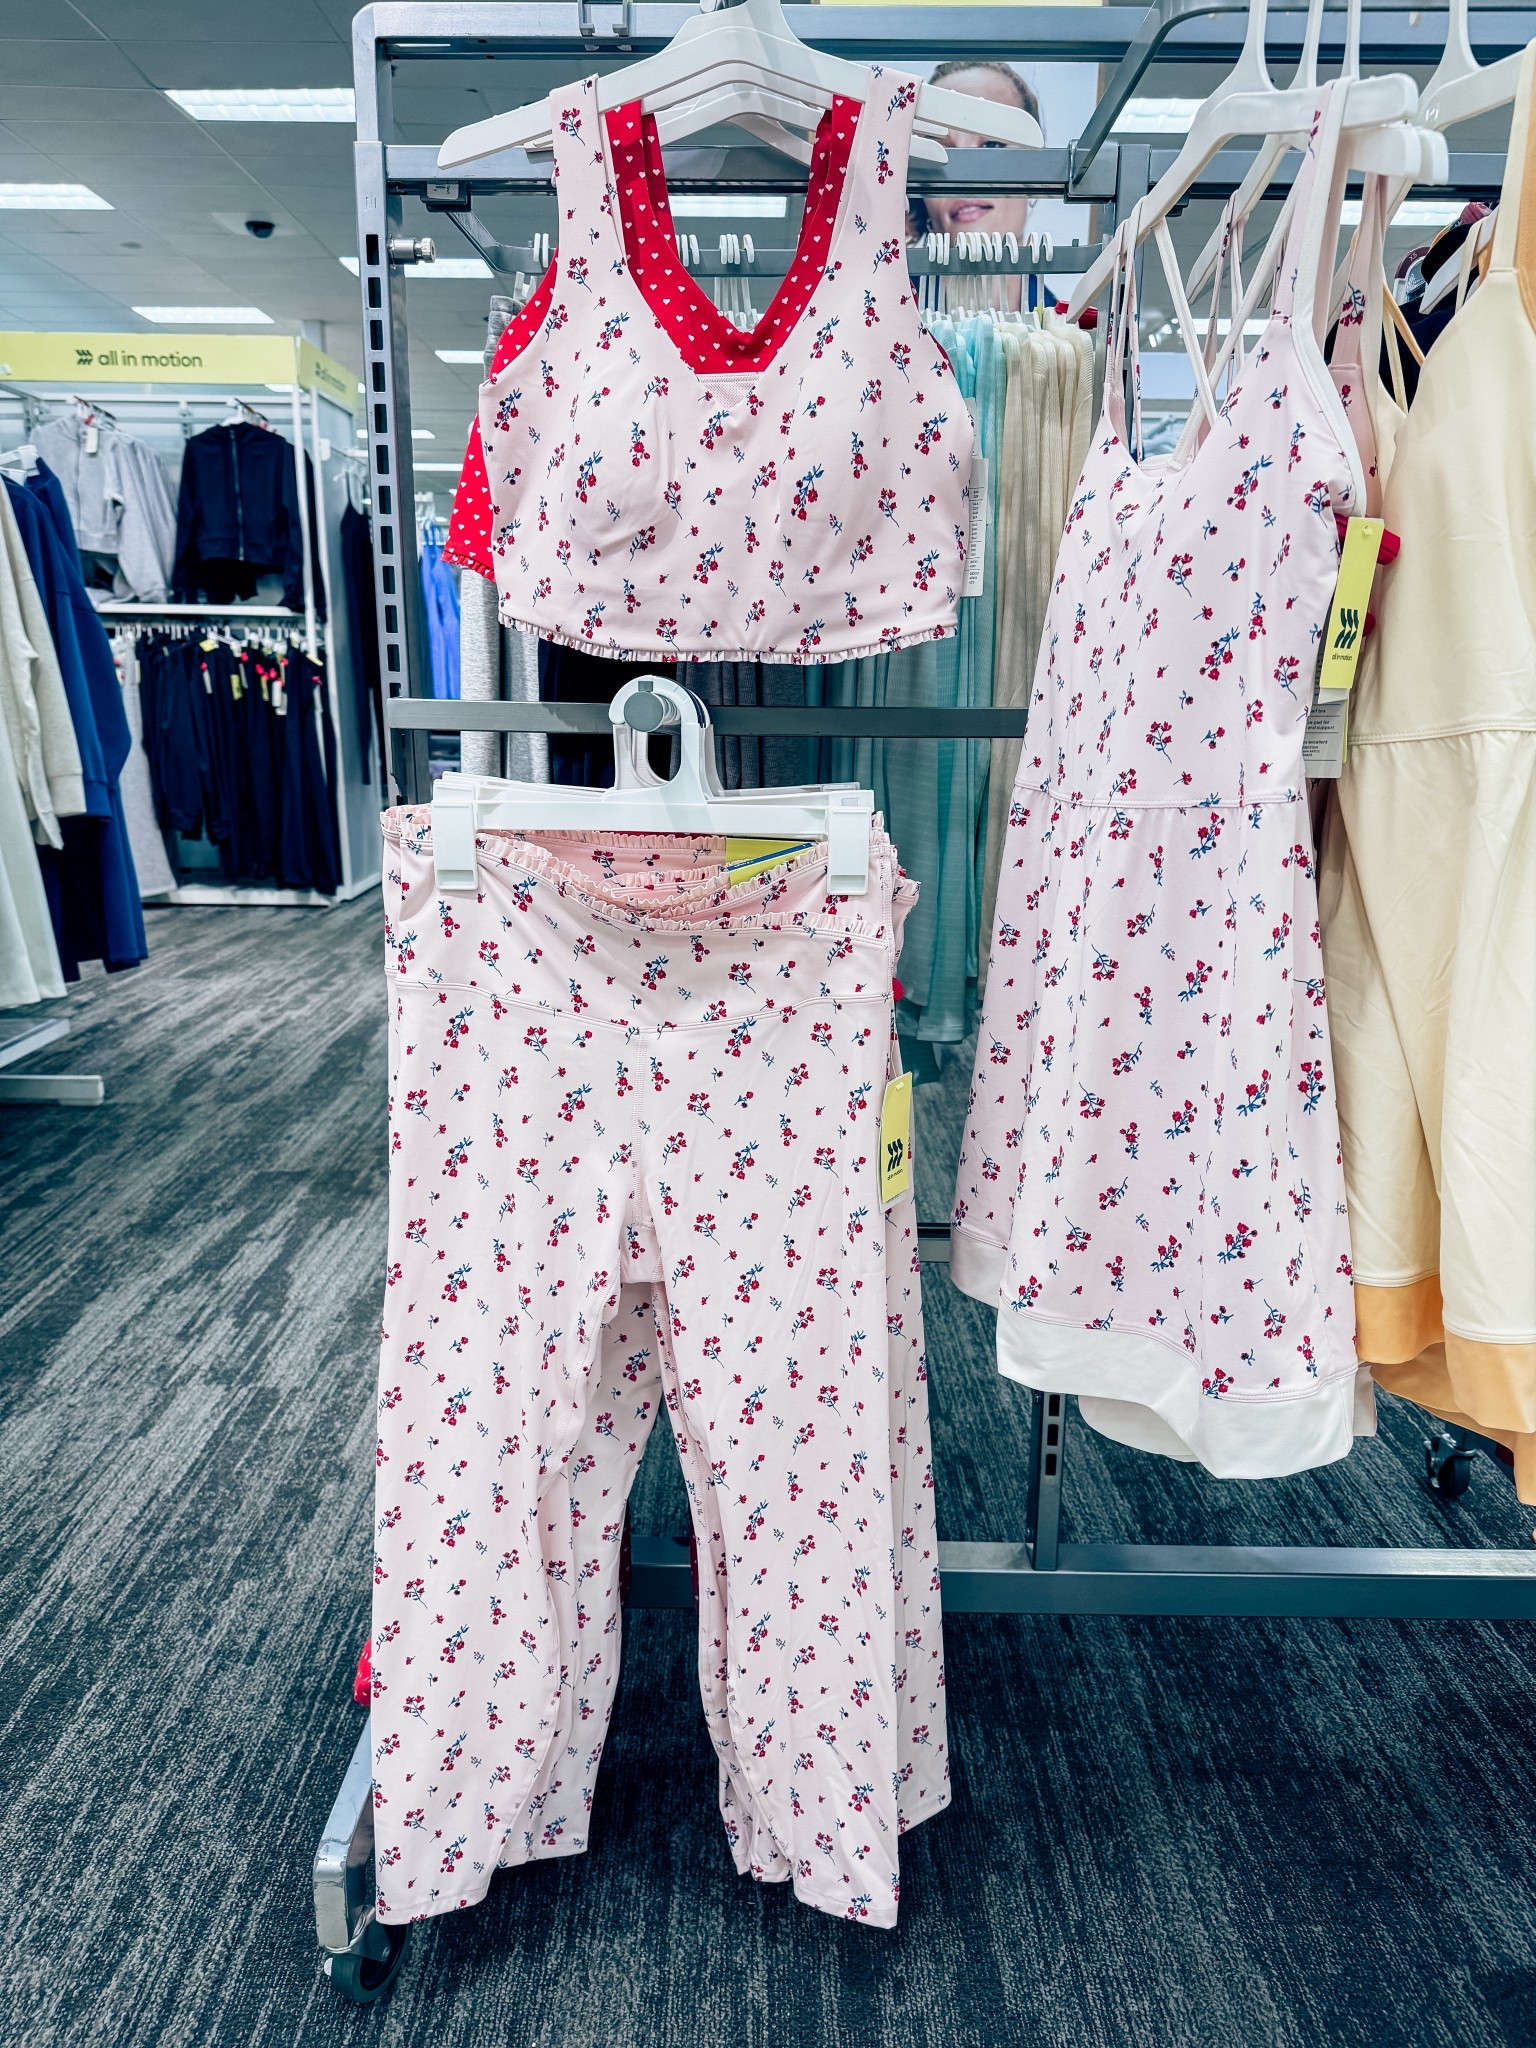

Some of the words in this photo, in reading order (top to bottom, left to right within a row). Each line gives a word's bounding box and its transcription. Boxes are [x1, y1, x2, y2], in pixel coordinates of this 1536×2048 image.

[1408, 252, 1418, 262] XS
[98, 350, 119, 366] all
[121, 350, 138, 366] in
[141, 351, 203, 367] motion
